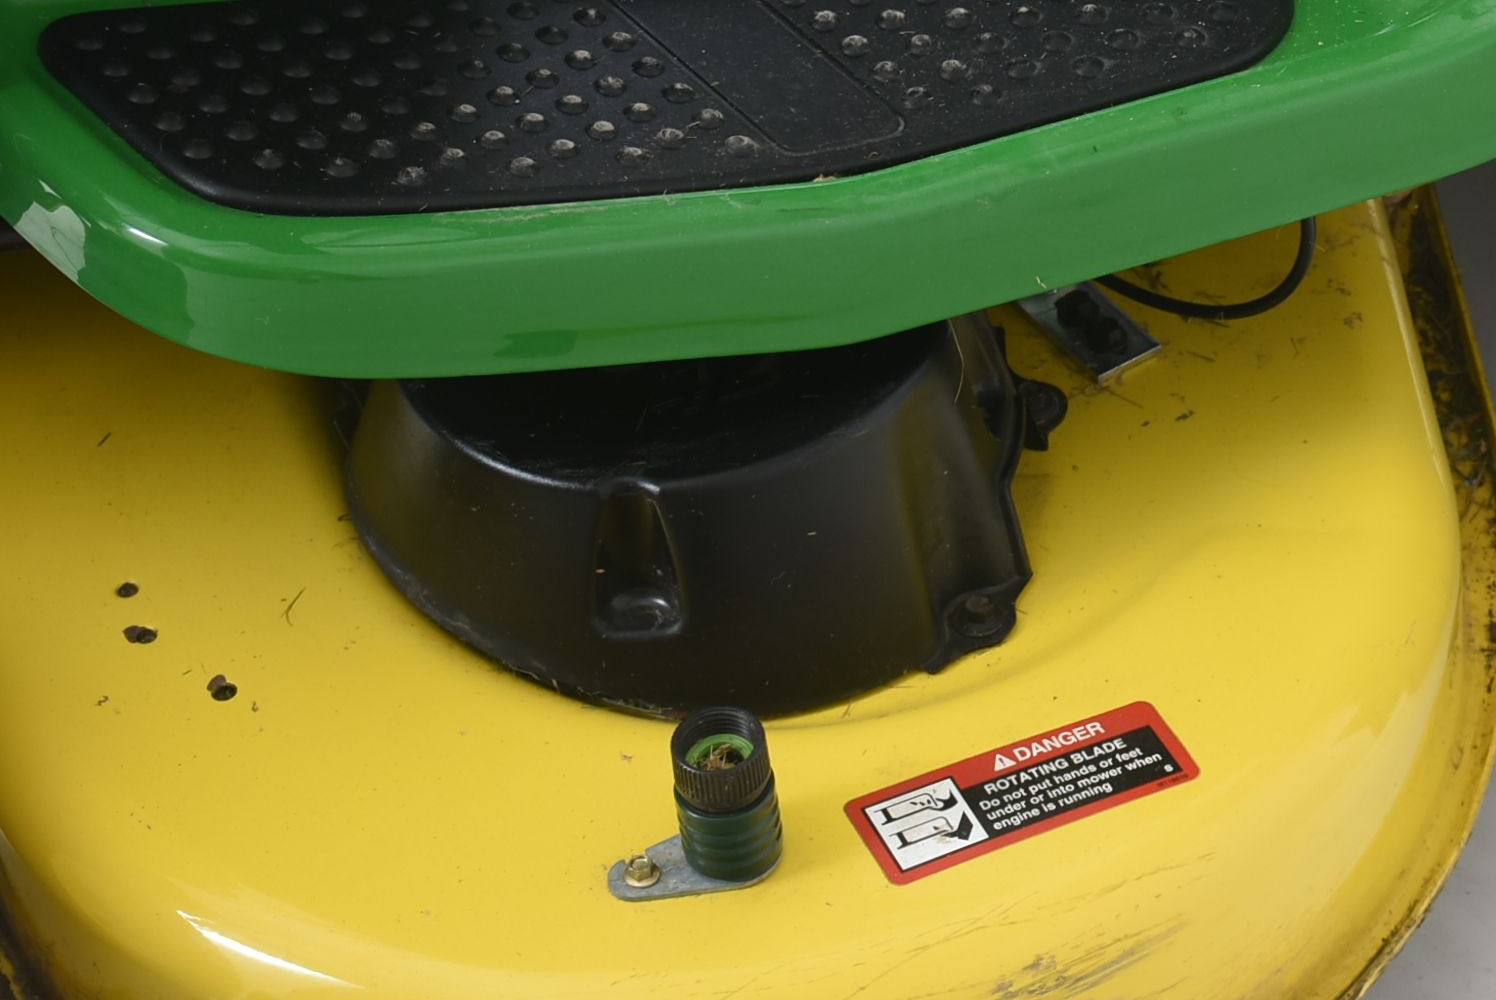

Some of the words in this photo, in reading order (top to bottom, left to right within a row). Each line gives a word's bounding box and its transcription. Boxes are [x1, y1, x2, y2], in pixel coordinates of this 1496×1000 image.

[983, 759, 1069, 795] ROTATING
[1070, 738, 1127, 764] BLADE
[1012, 721, 1106, 761] DANGER
[979, 799, 1000, 810] Do
[1005, 789, 1027, 803] not
[1029, 780, 1054, 796] put
[1054, 764, 1096, 784] hands
[1099, 757, 1114, 768] or
[1115, 747, 1143, 762] feet
[987, 801, 1027, 821] under
[1030, 795, 1044, 805] or
[1047, 784, 1074, 799] into
[1077, 765, 1123, 789] mower
[1125, 753, 1162, 771] when
[993, 808, 1041, 830] engine
[1043, 802, 1056, 812] is
[1059, 783, 1112, 807] running
